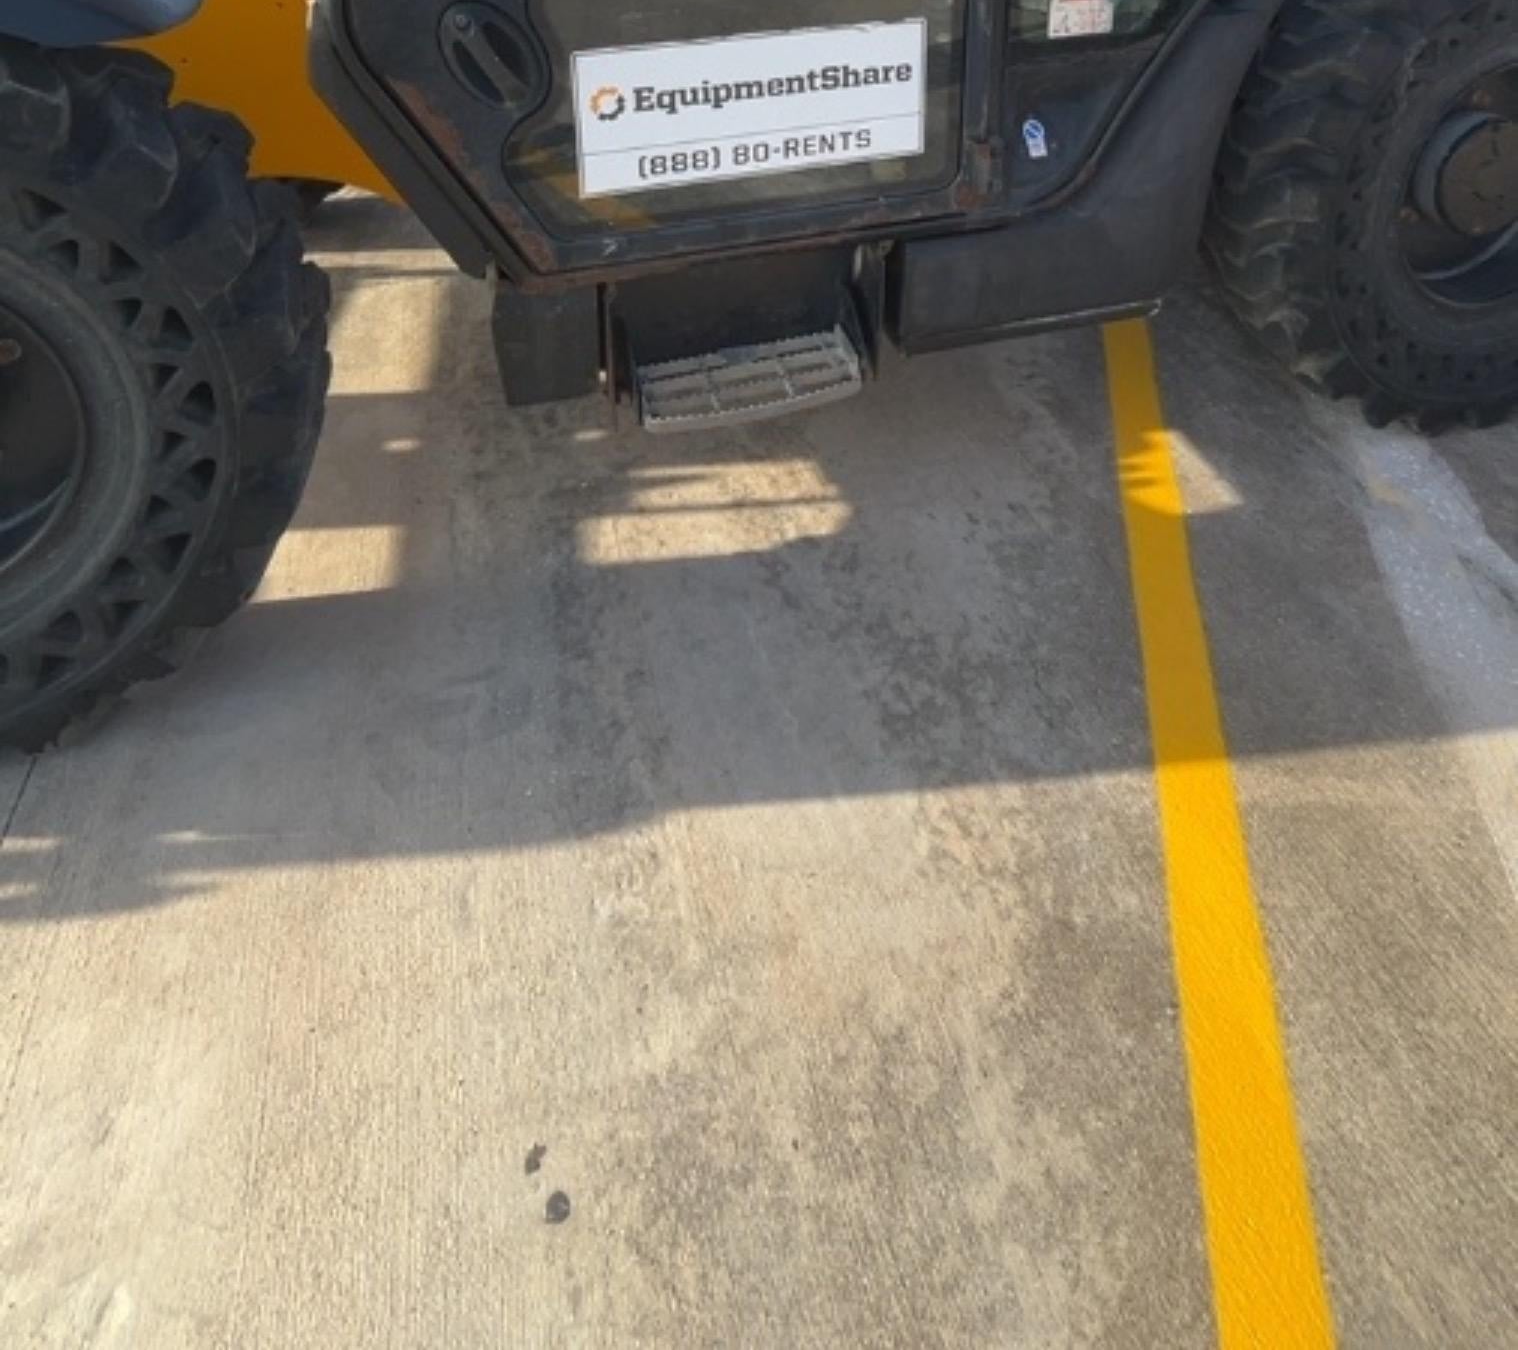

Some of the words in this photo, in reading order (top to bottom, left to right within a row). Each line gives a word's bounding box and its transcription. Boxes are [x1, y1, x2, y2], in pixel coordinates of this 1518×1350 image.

[633, 63, 912, 114] EquipmentShare
[638, 146, 721, 179] (888)
[732, 129, 872, 166] 80-RENTS
